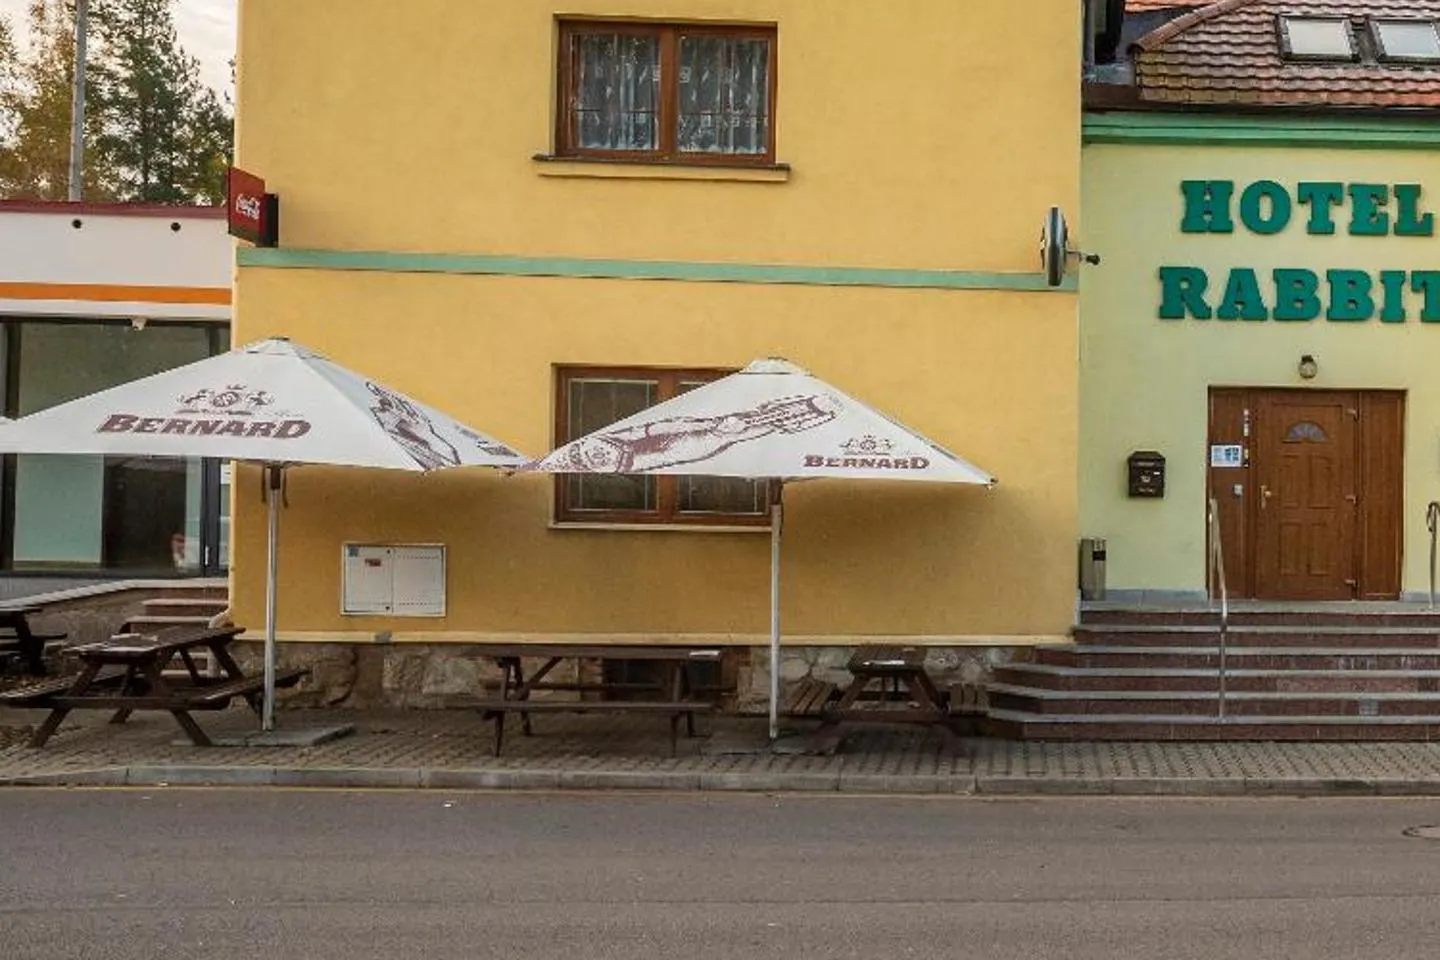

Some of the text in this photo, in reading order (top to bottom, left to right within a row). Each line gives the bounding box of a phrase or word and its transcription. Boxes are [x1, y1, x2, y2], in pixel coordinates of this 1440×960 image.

[1180, 179, 1434, 236] HOTEL
[97, 413, 312, 440] BERNARD
[804, 455, 930, 469] BERNARD
